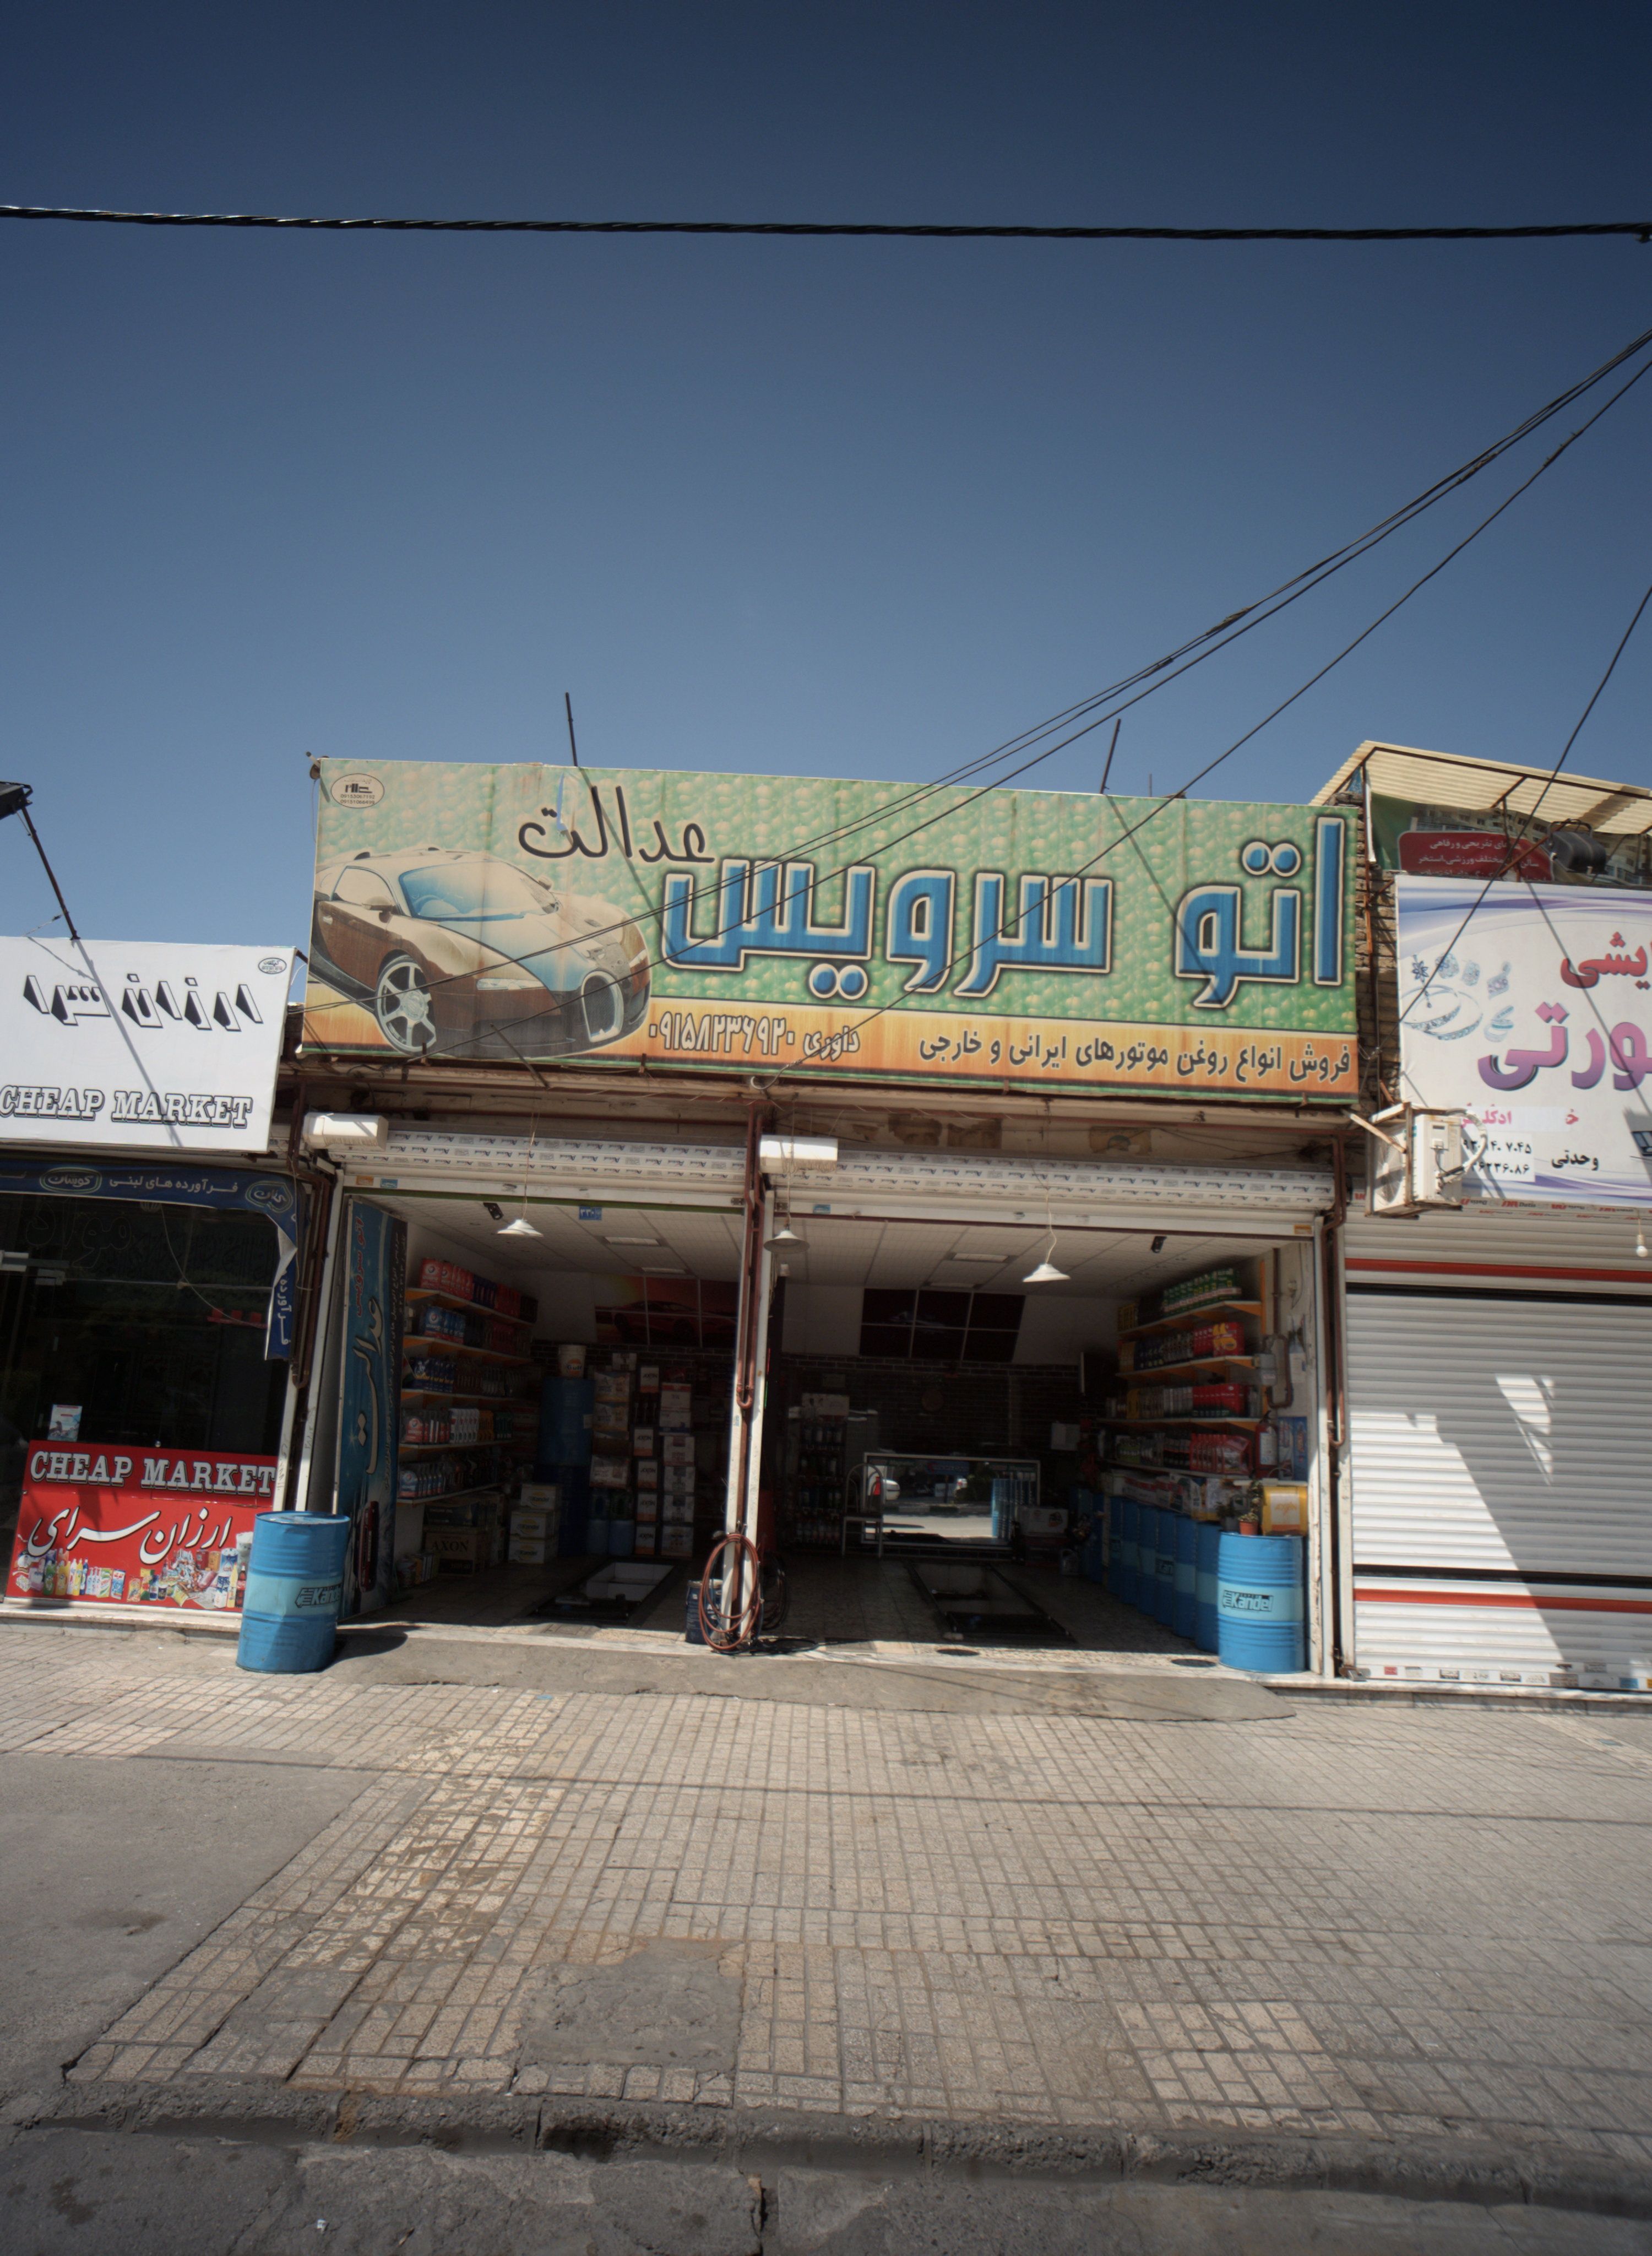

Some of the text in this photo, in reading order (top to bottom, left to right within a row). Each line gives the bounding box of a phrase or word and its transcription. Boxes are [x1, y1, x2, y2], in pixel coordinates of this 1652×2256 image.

[518, 785, 715, 863] عدالت
[662, 816, 1346, 1010] اتو سرویس
[23, 973, 264, 1032] ارزان سرا
[803, 1026, 860, 1062] داوری
[920, 1029, 982, 1063] خارجی
[990, 1039, 1001, 1065] و
[1009, 1033, 1067, 1069] ایرانی
[1177, 1039, 1227, 1077] روغن
[1290, 1043, 1351, 1083] فروش
[1478, 1002, 1652, 1091] ورتی
[1236, 1046, 1281, 1083] انواع
[0, 1084, 253, 1129] CHEAP MARKET
[1552, 1151, 1600, 1171] وحدتی
[110, 1175, 143, 1188] لبنی
[145, 1176, 173, 1189] های
[353, 1216, 366, 1317] اتو سرویس
[353, 1298, 383, 1475] عدالت
[30, 1450, 133, 1488] CHEAP
[140, 1457, 276, 1498] MARKET
[26, 1506, 233, 1565] ارزان سرای
[432, 1539, 469, 1552] AXON
[1231, 1591, 1274, 1612] Kandel
